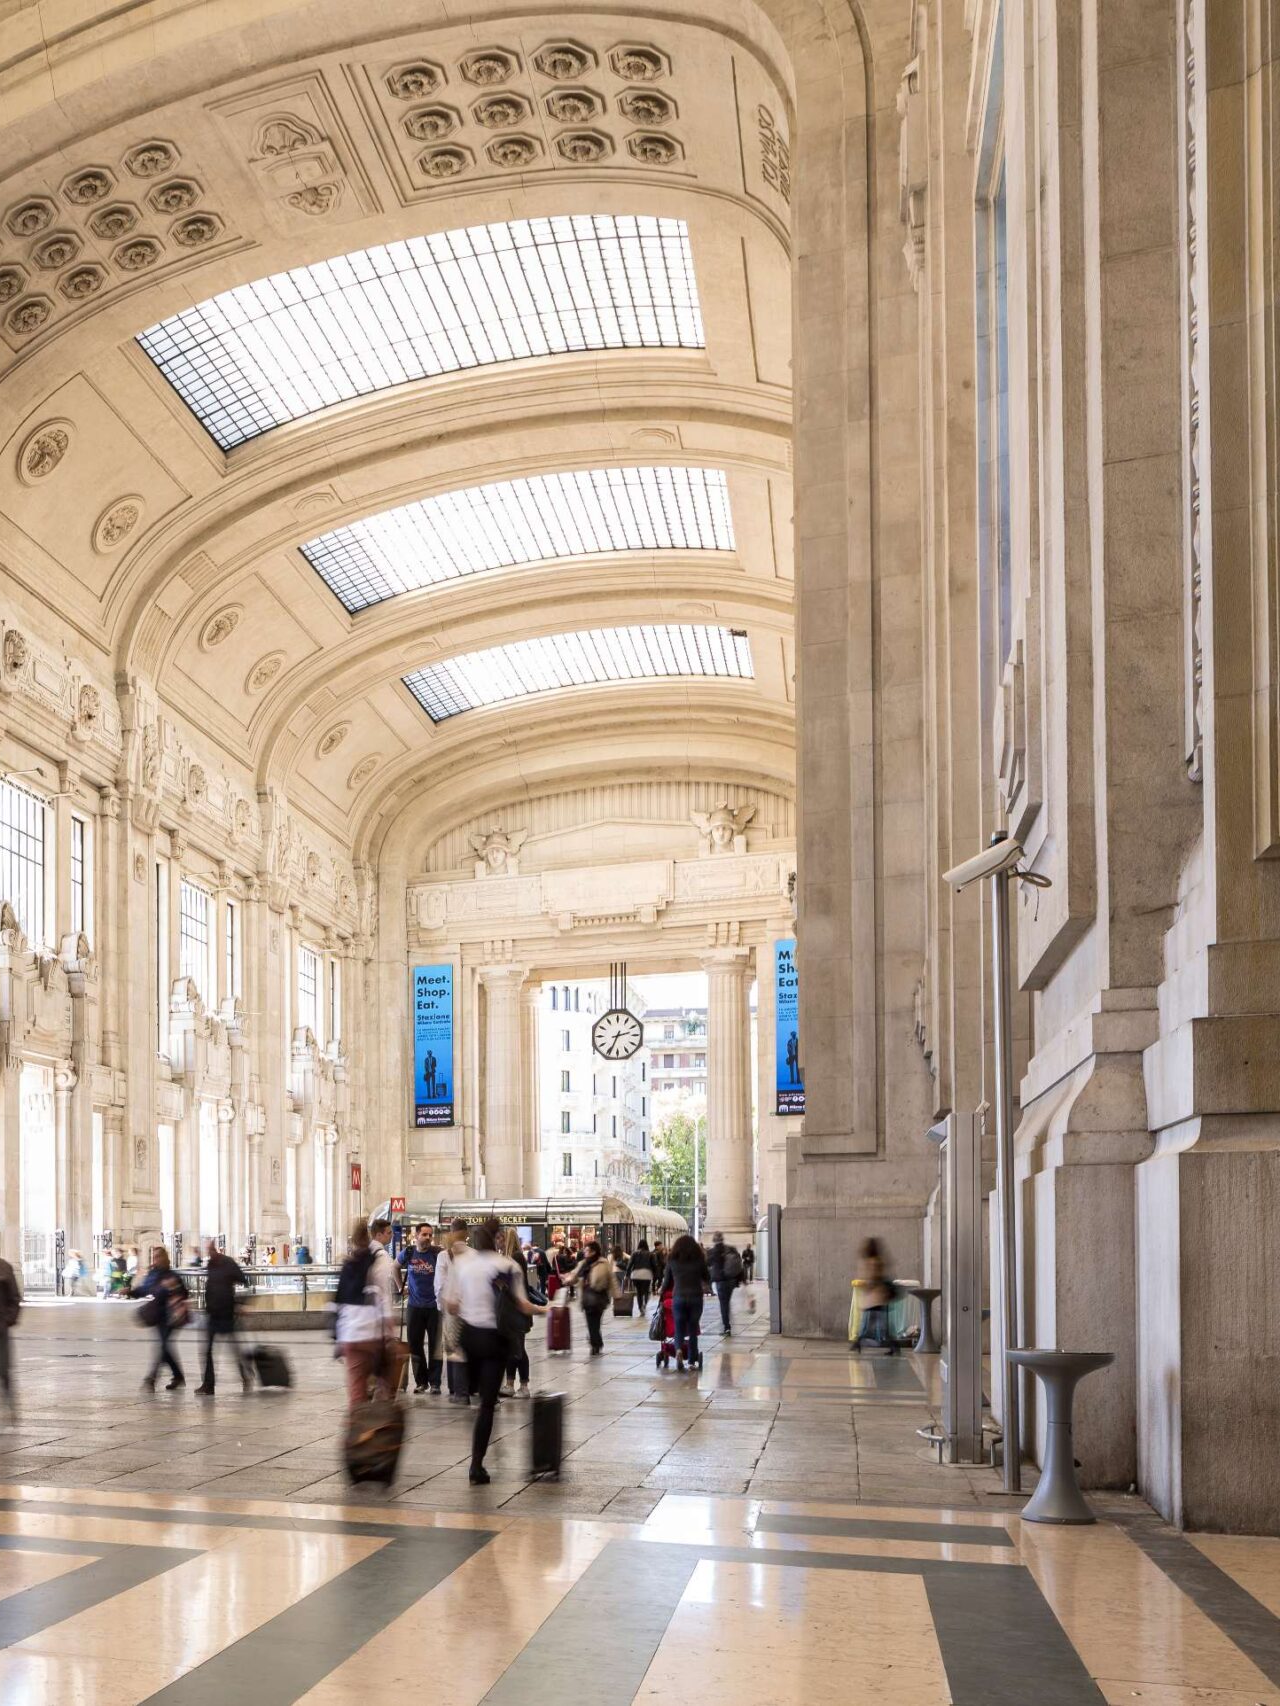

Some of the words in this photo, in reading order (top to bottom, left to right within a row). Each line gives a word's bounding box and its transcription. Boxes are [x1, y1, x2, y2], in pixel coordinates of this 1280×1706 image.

[417, 975, 450, 985] Meet.
[417, 987, 450, 999] Shop.
[417, 1000, 439, 1010] Eat.
[417, 1013, 451, 1021] Stazione
[352, 1169, 361, 1185] M
[391, 1199, 405, 1210] M
[499, 1216, 528, 1224] SECRET
